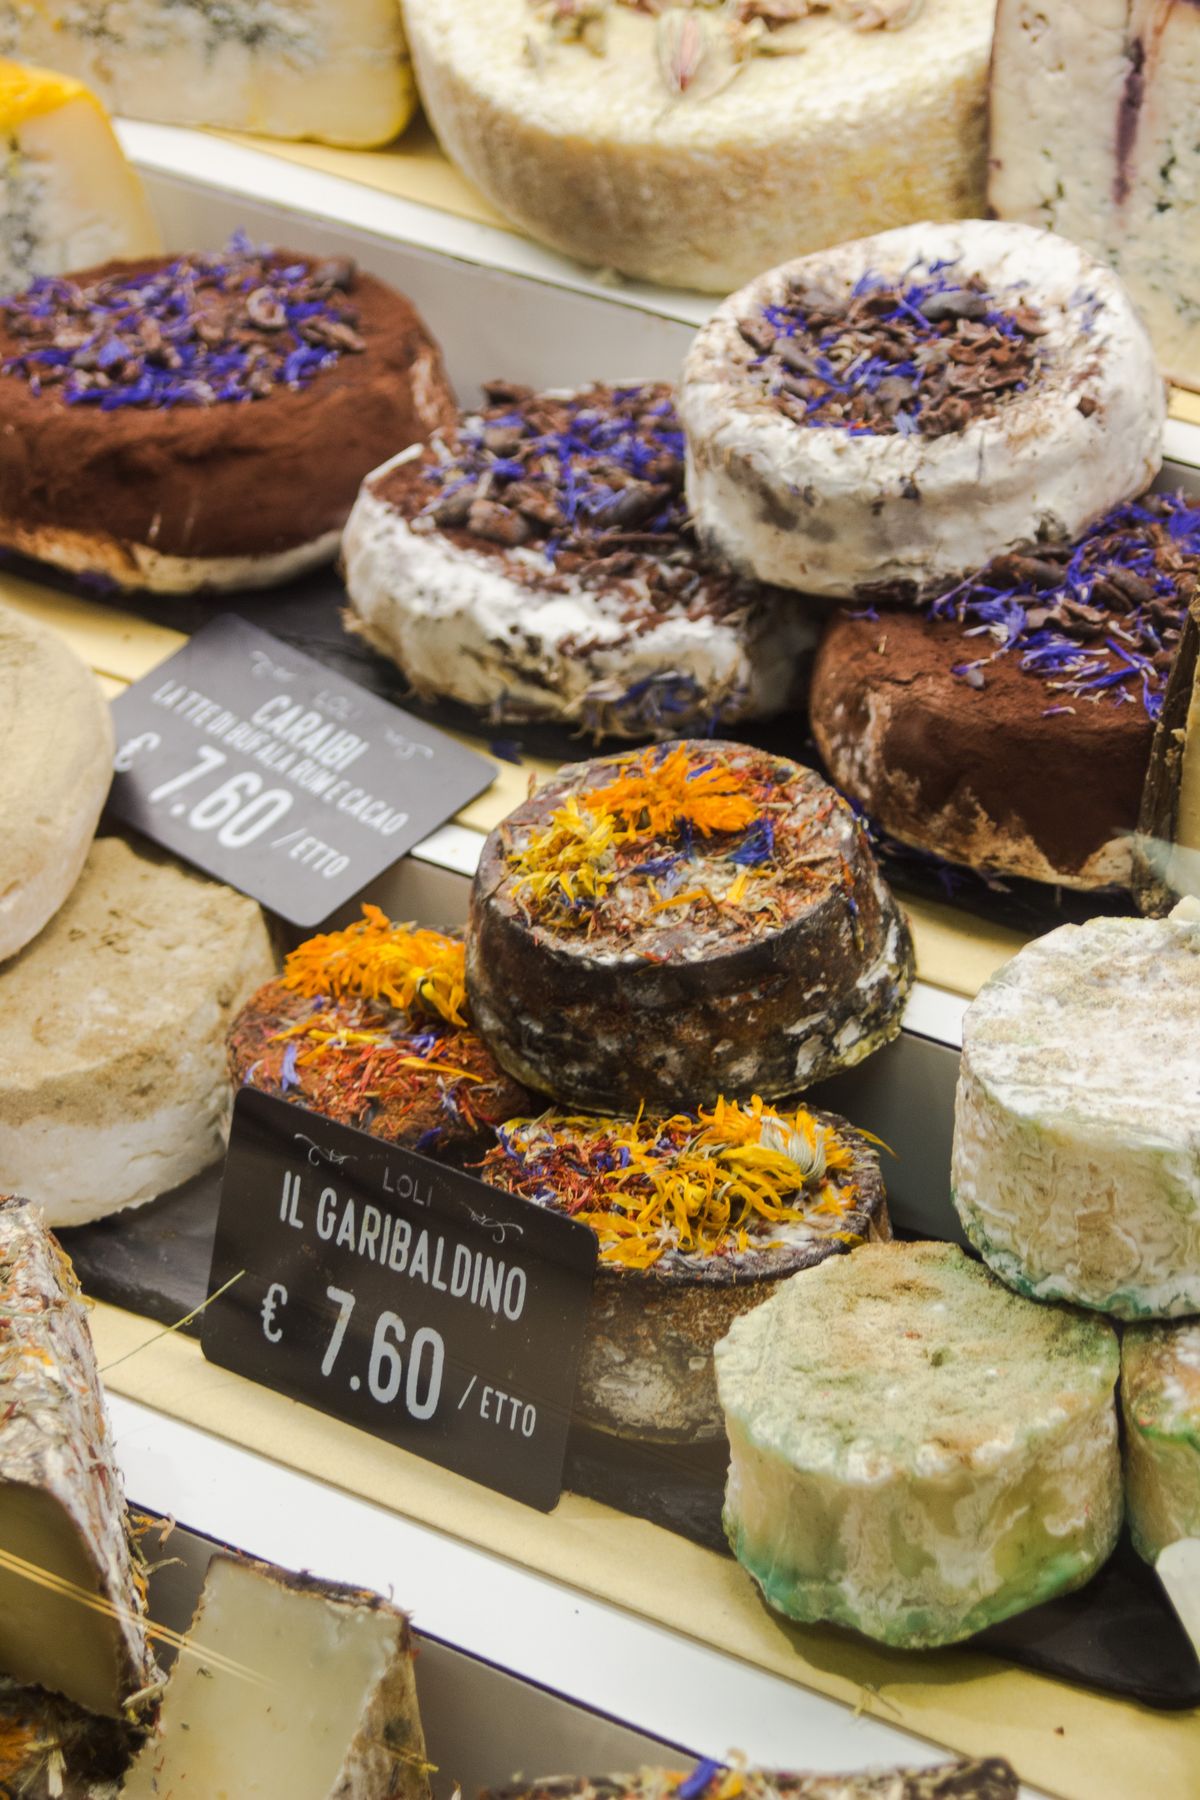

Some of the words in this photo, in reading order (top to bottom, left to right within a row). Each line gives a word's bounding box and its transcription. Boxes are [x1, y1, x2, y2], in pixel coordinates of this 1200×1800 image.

[151, 679, 223, 728] LATTE
[205, 711, 239, 738] DI
[223, 721, 297, 775] BUFALA
[251, 694, 370, 772] CARAIBI
[113, 731, 161, 772] €
[148, 744, 294, 849] 7.60
[286, 758, 338, 796] RUM
[322, 779, 351, 803] E
[336, 787, 409, 836] CACAO
[382, 1166, 434, 1208] LOLI
[279, 1170, 304, 1230] IL
[316, 1187, 527, 1322] GARIBALDINO
[260, 1283, 288, 1343] €
[320, 1286, 446, 1421] 7.60
